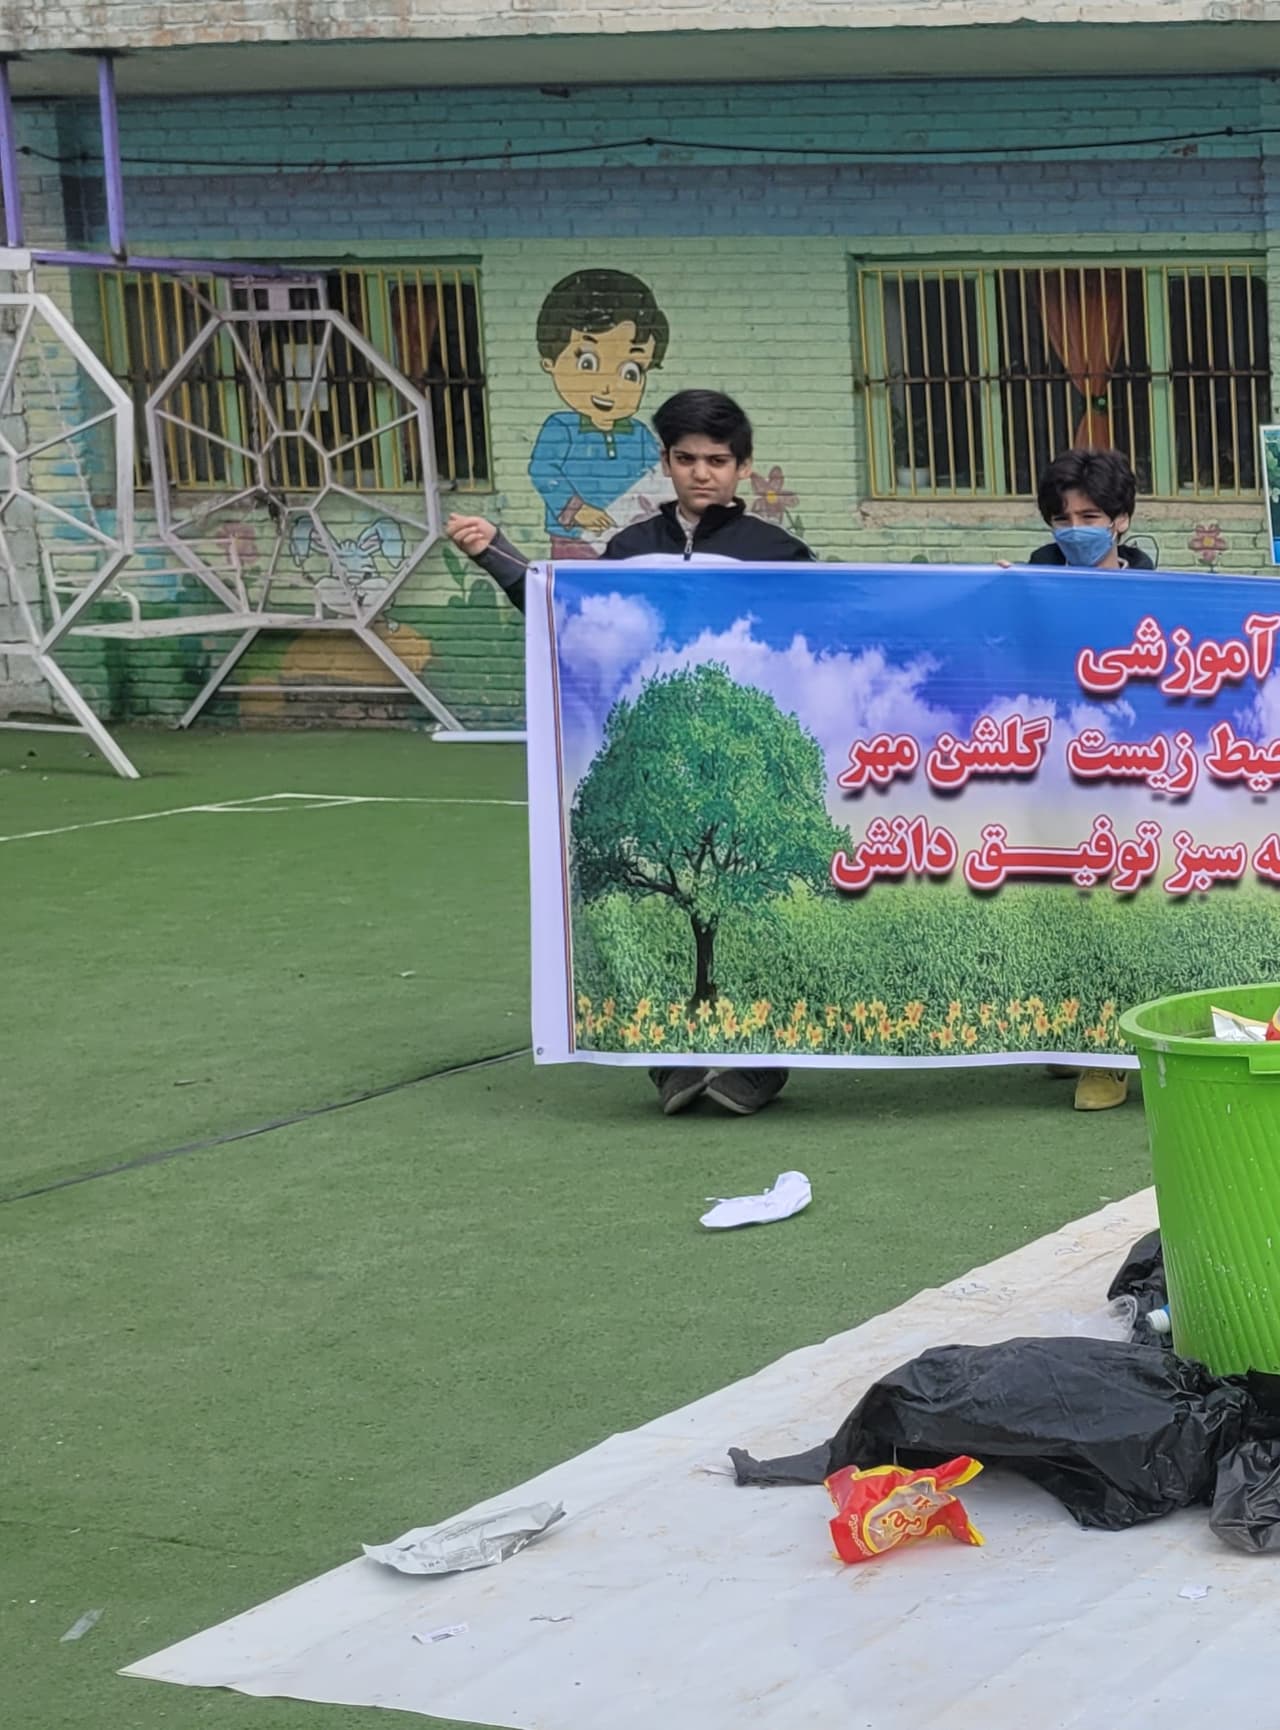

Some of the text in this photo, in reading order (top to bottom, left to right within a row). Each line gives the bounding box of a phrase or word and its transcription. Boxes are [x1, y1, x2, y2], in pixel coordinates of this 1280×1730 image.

[839, 730, 918, 791] مهر
[928, 712, 1053, 794] گلشن
[1067, 723, 1198, 795] زیست
[831, 814, 958, 894] دانش
[964, 814, 1161, 894] توفیق
[1167, 830, 1247, 895] سبز
